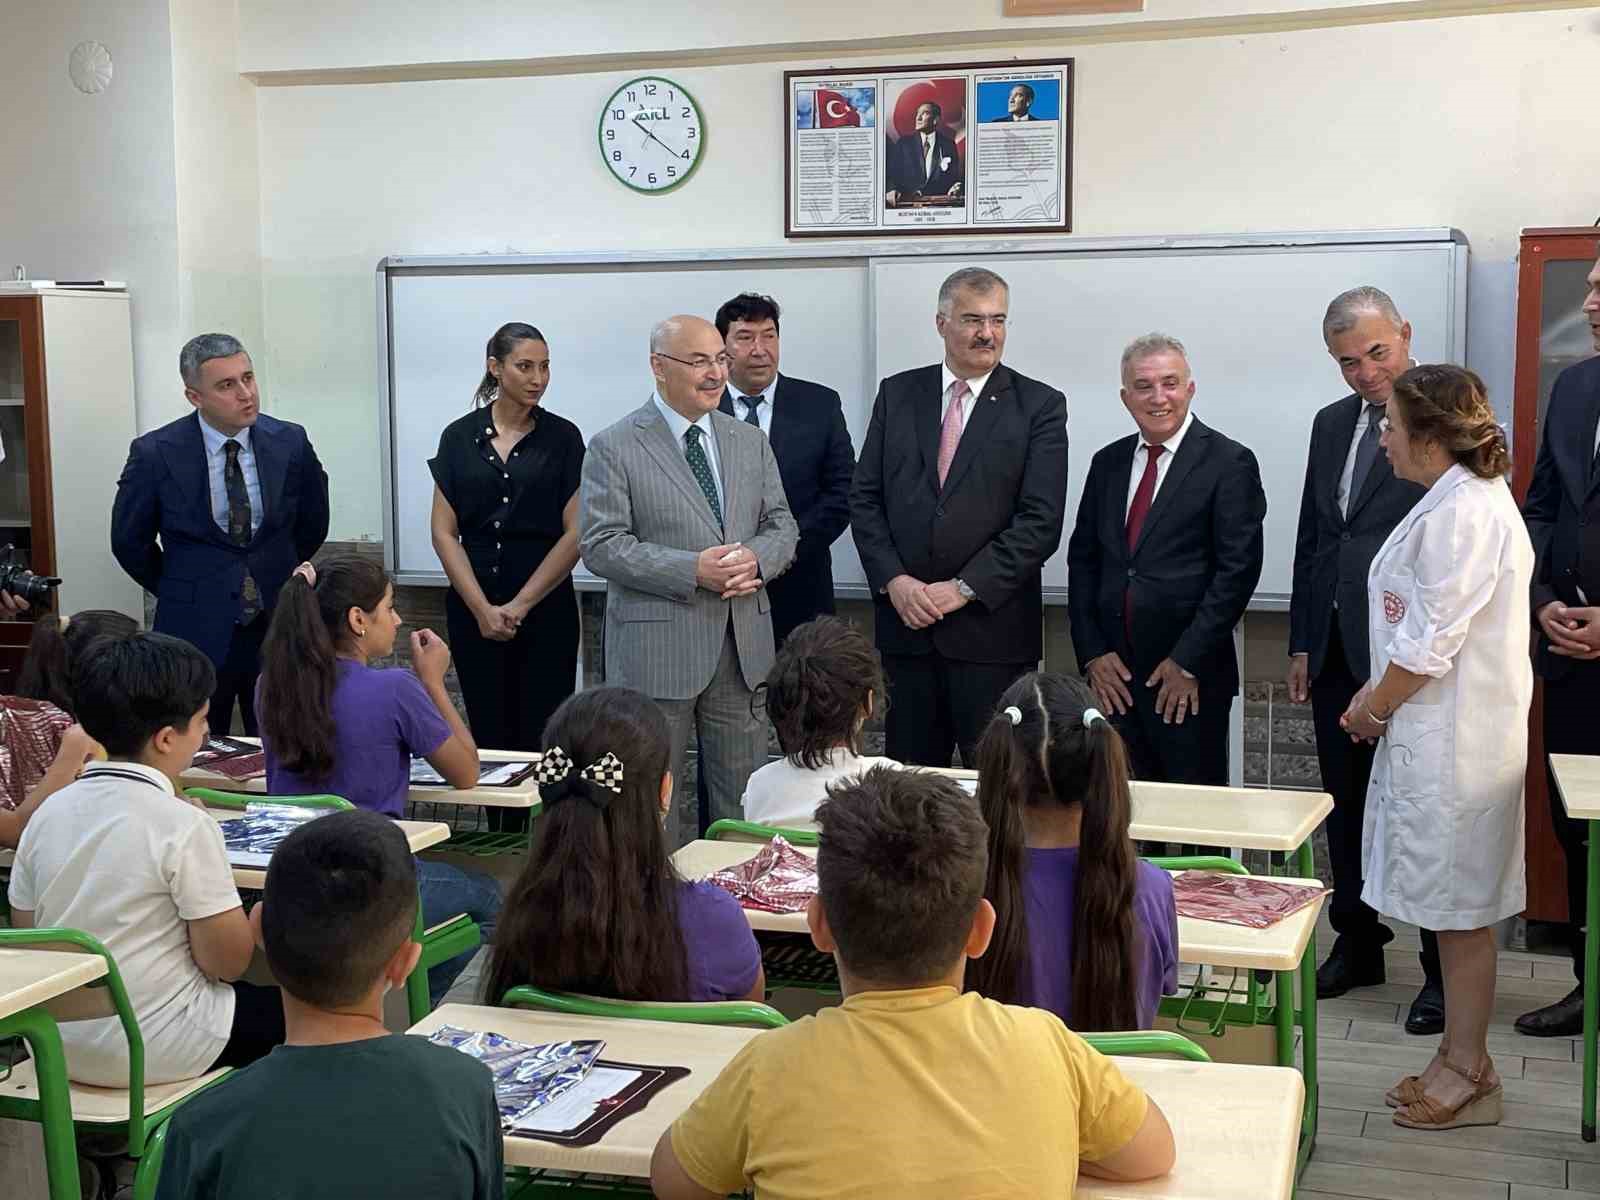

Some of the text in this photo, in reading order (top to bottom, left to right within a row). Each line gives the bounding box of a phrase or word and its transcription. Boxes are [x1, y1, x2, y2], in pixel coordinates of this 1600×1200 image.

[644, 84, 657, 96] 12
[627, 91, 636, 102] 11
[668, 90, 674, 102] 1
[612, 109, 625, 120] 10
[682, 107, 691, 118] 2
[606, 129, 615, 140] 9
[688, 127, 696, 139] 3
[613, 150, 622, 161] 8
[681, 149, 690, 160] 4
[628, 166, 637, 178] 7
[667, 166, 676, 177] 5
[648, 173, 657, 183] 6
